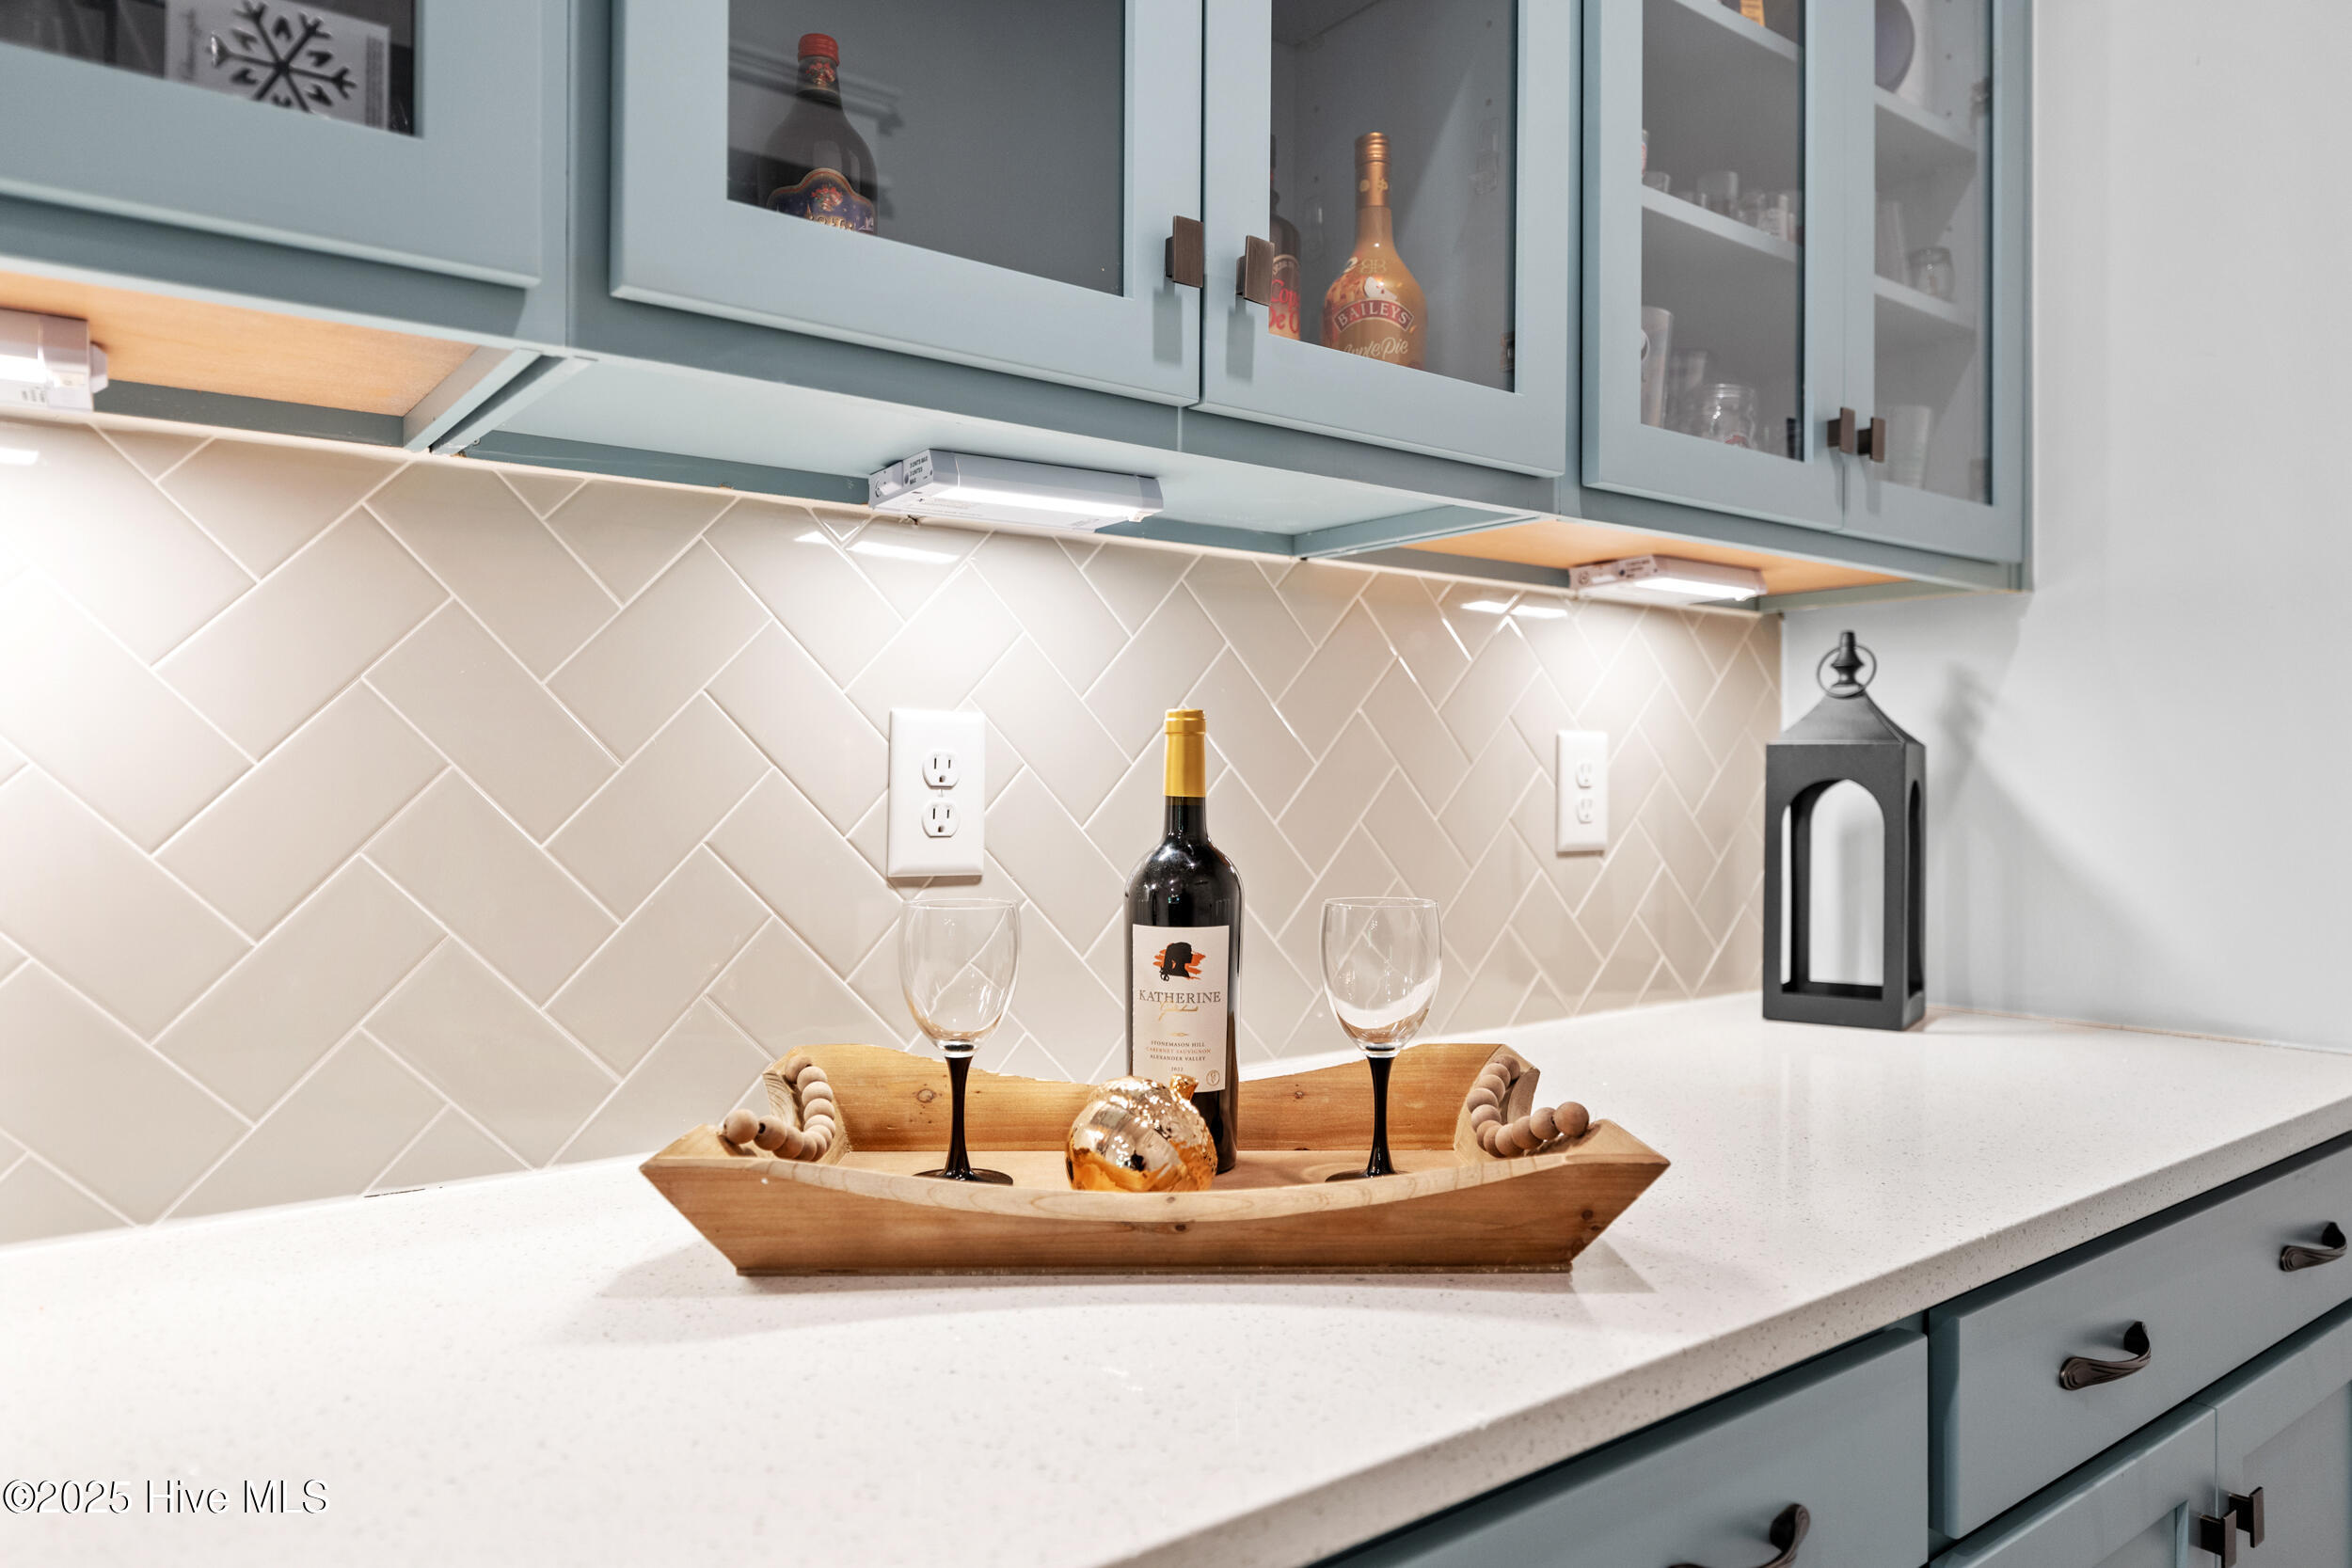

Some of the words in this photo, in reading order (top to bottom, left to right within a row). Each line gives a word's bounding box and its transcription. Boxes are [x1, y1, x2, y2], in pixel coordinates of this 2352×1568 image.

[1338, 302, 1409, 326] BAILEYS
[1382, 338, 1408, 359] Pie
[1138, 990, 1221, 1004] KATHERINE
